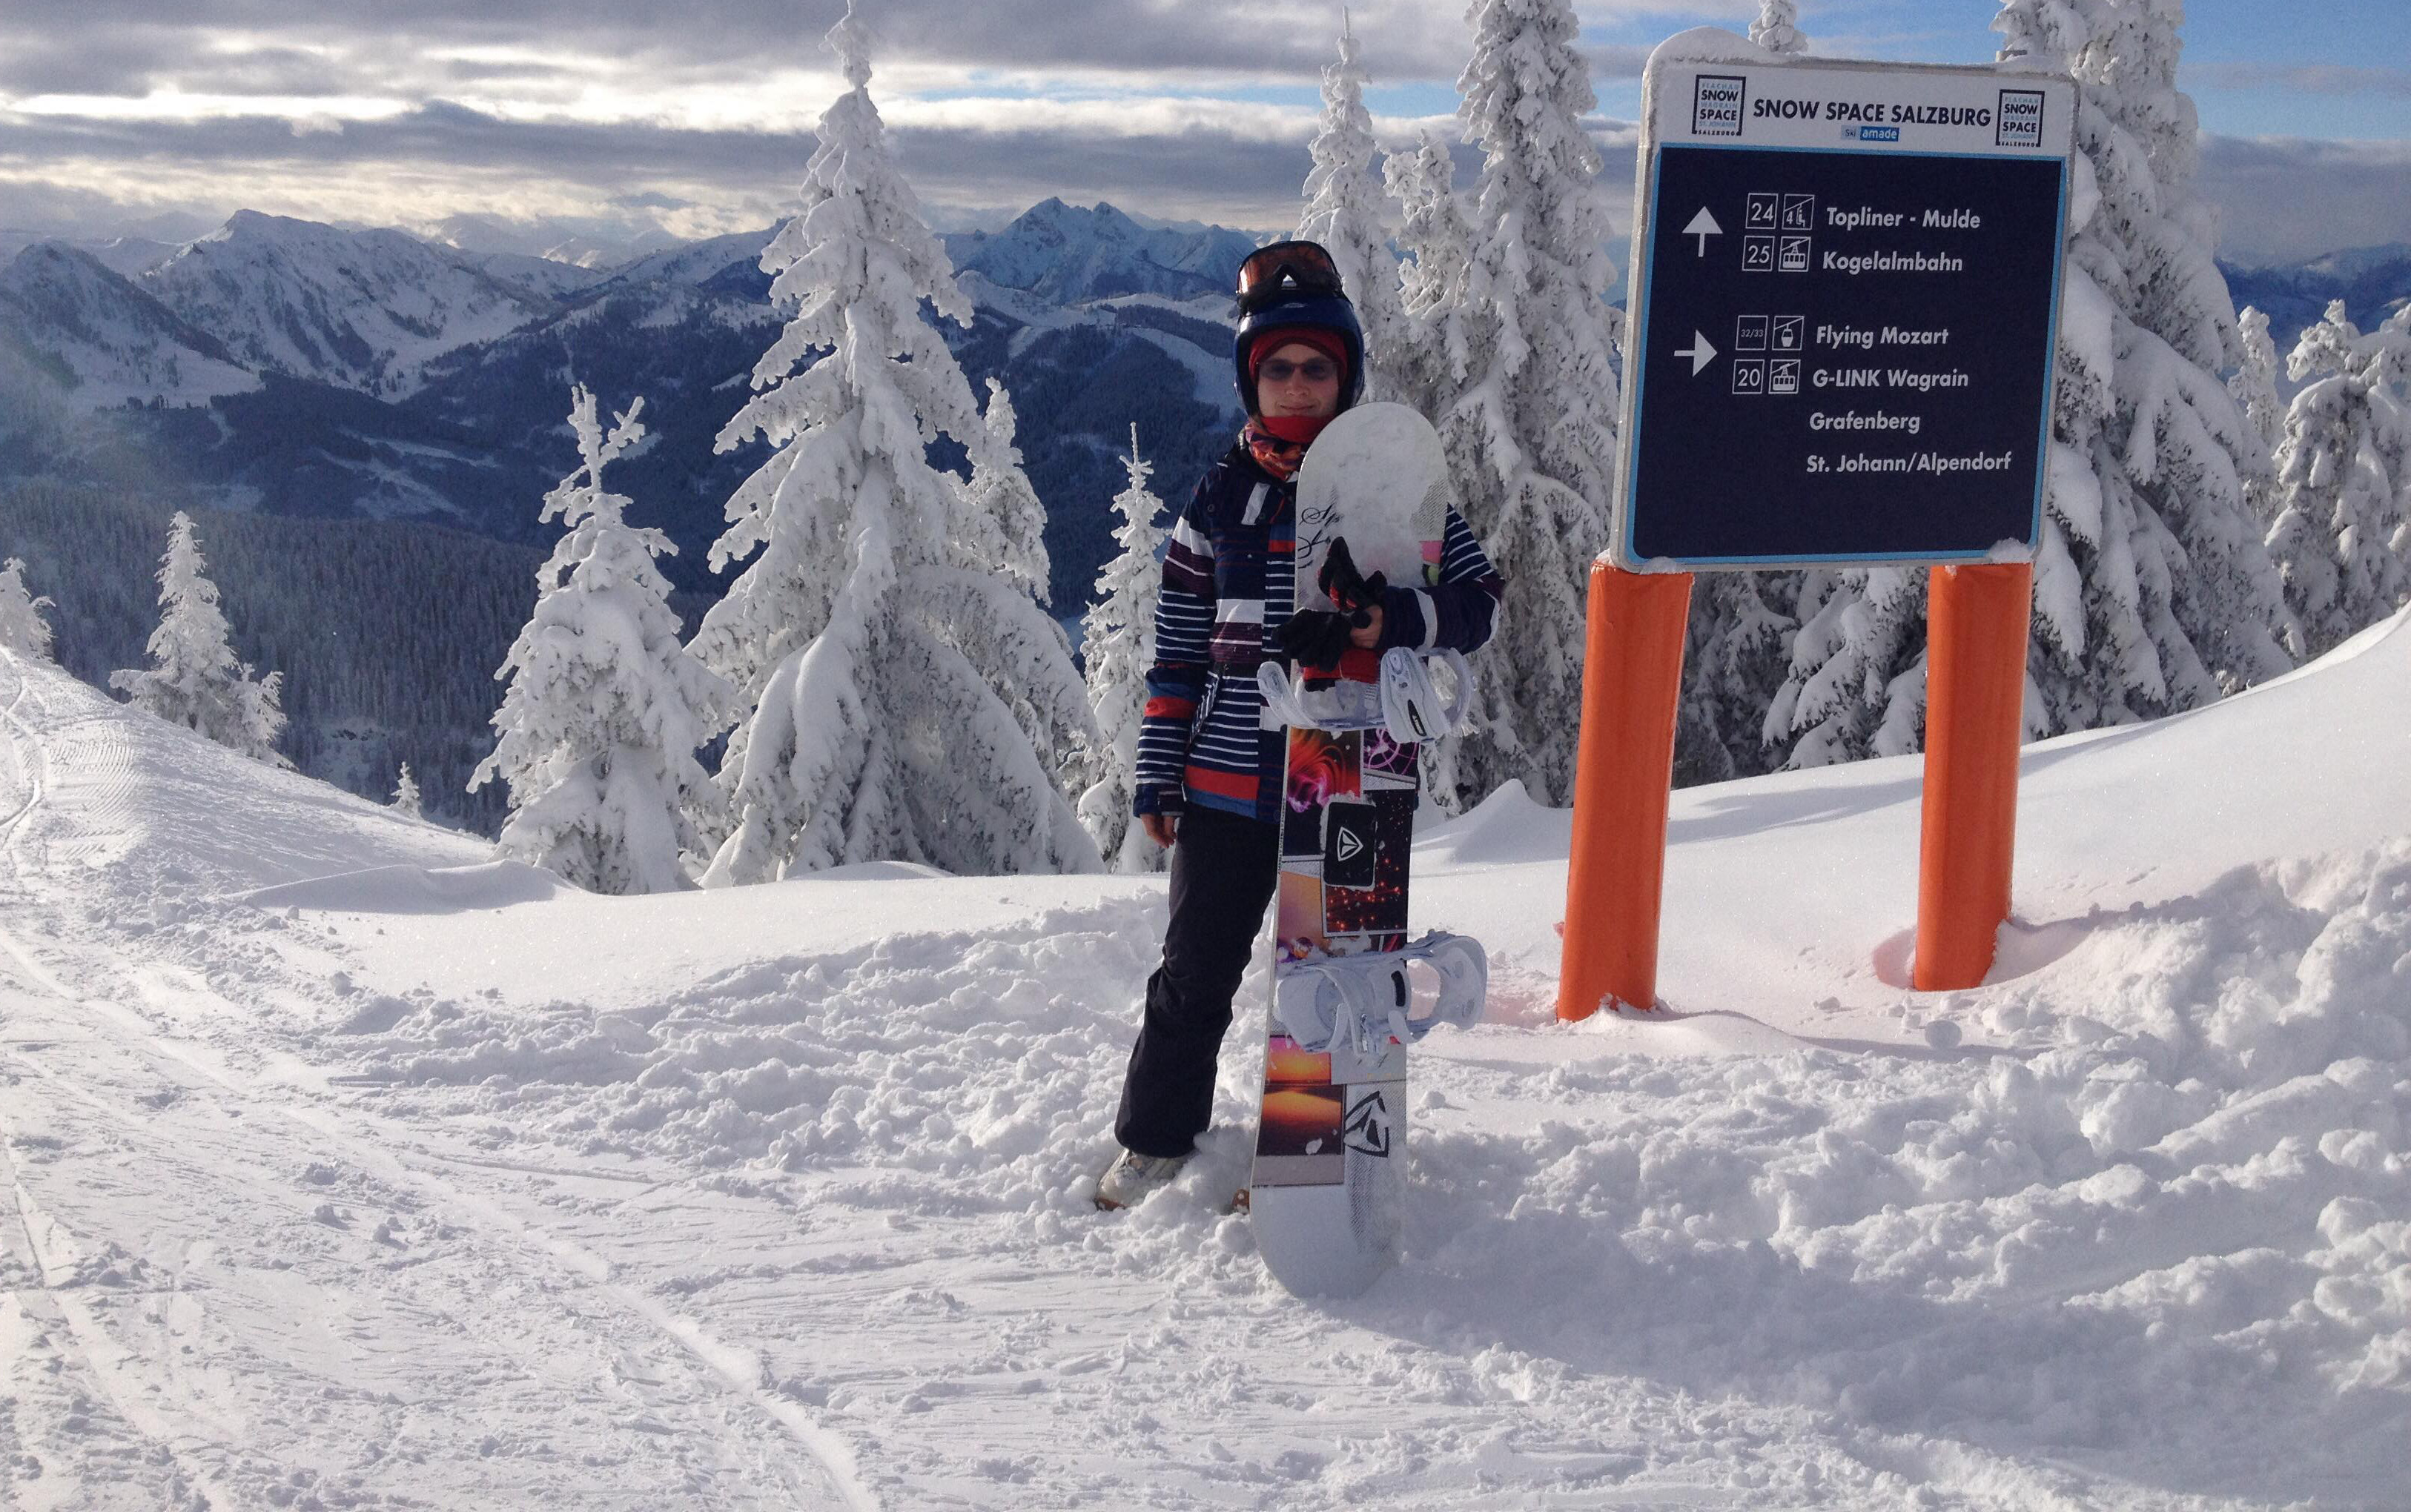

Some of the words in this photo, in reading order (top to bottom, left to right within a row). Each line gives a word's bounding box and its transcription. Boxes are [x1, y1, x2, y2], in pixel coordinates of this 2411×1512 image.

[1701, 90, 1739, 102] SNOW
[1700, 109, 1737, 120] SPACE
[1753, 98, 1820, 119] SNOW
[1825, 102, 1885, 122] SPACE
[1891, 105, 1991, 126] SALZBURG
[2004, 103, 2038, 115] SNOW
[2002, 121, 2037, 133] SPACE
[1750, 202, 1774, 222] 24
[1786, 210, 1793, 225] 4
[1826, 206, 1903, 231] Topliner
[1922, 208, 1981, 229] Mulde
[1747, 245, 1770, 264] 25
[1822, 251, 1963, 275] Kogelalmbahn
[1740, 328, 1764, 339] 32/33
[1816, 325, 1874, 350] Flying
[1879, 326, 1949, 345] Mozart
[1737, 368, 1761, 387] 20
[1813, 368, 1882, 388] G-LINK
[1887, 368, 1969, 392] Wagrain
[1809, 410, 1921, 434] Grafenberg
[1806, 454, 1830, 473] St.
[1836, 450, 2012, 476] Johann/Alpendorf
